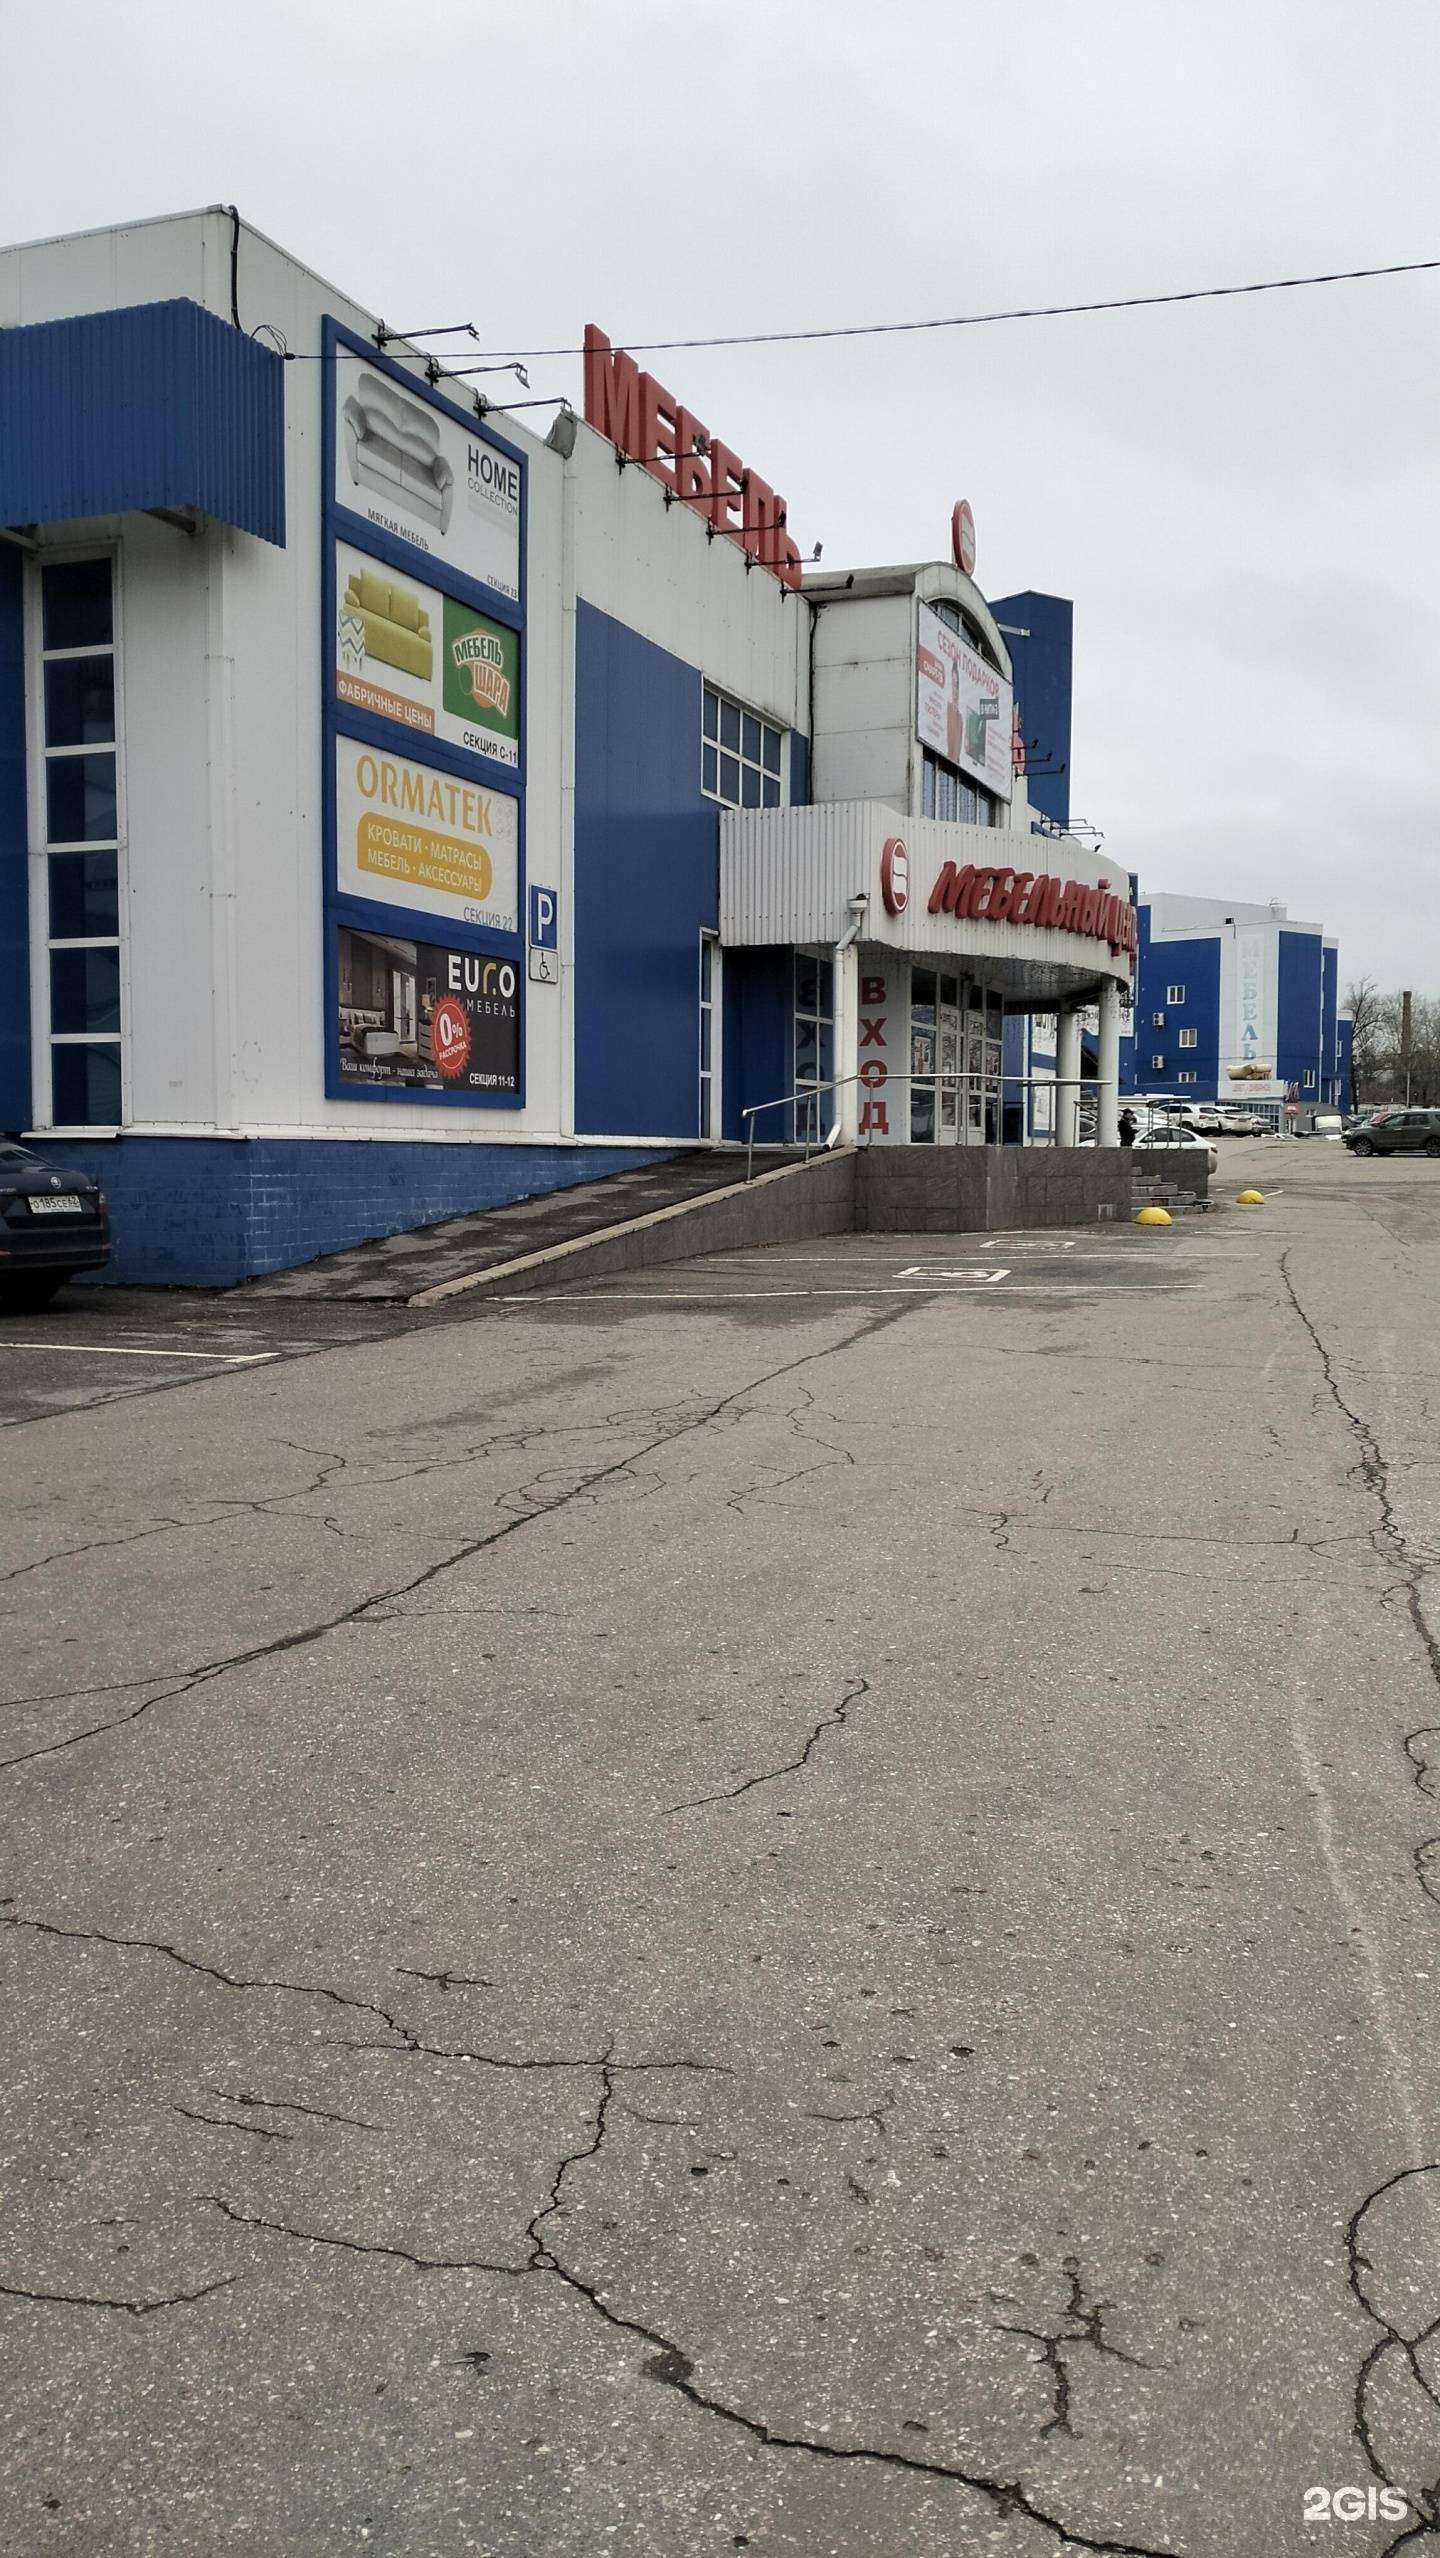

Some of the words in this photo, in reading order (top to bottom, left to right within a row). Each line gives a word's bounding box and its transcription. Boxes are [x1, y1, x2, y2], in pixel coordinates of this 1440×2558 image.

[468, 444, 518, 501] HOME
[585, 323, 802, 590] МЕБЕЛЬ
[467, 477, 518, 516] COLLECTION
[367, 508, 398, 533] МЯГКАЯ
[400, 526, 429, 550] МЕБЕЛЬ
[455, 634, 503, 666] МЕБЕЛЬ
[338, 680, 402, 716] ФАБРИЧНЫЕ
[404, 705, 432, 729] ЦЕНЫ
[463, 731, 498, 756] СЕКЦИЯ
[499, 744, 518, 763] С-11
[356, 754, 493, 837] ORMATEK
[368, 823, 421, 854] КРОВАТИ
[431, 842, 482, 871] МАТРАСЫ
[368, 848, 410, 874] МЕБЕЛЬ
[418, 862, 482, 892] АКСЕССУАРЫ
[464, 906, 500, 928] СЕКЦИЯ
[502, 915, 513, 931] 22
[928, 861, 1111, 941] МЕБЕЛЬНЫЙ
[466, 999, 516, 1018] МЕБЕЛЬ
[439, 1012, 463, 1047] 0%
[340, 1058, 358, 1072] Ваш
[359, 1057, 391, 1080] комфорт
[439, 1041, 467, 1060] РАССРОЧКА
[859, 977, 889, 1135] ВХОД
[469, 1072, 497, 1087] СЕКЦИЯ
[498, 1073, 515, 1087] 11-12
